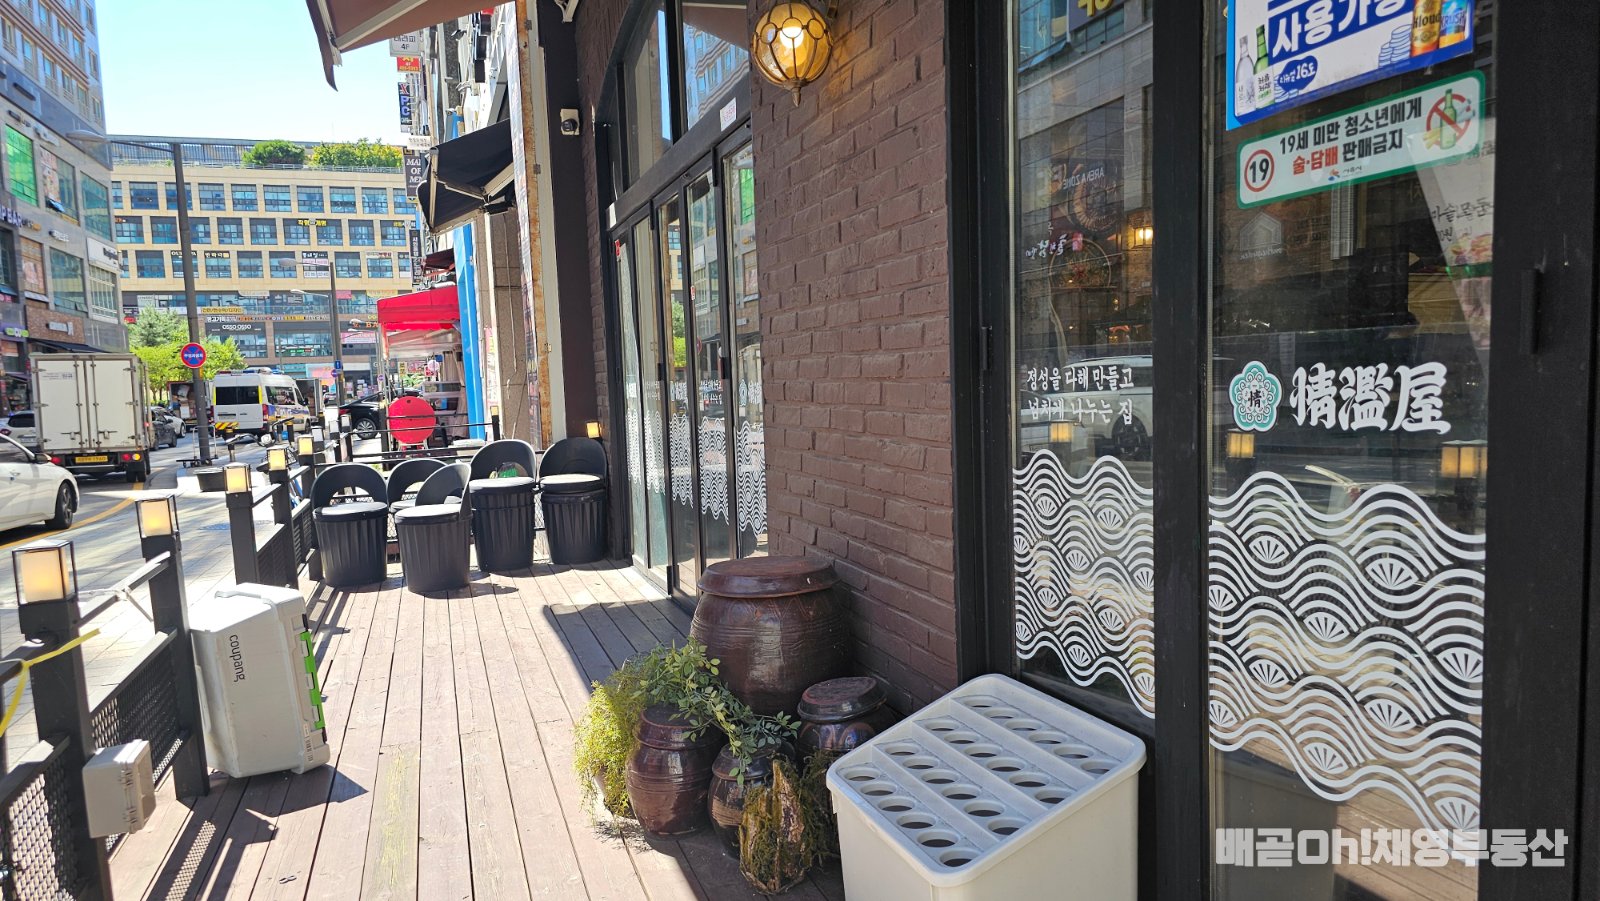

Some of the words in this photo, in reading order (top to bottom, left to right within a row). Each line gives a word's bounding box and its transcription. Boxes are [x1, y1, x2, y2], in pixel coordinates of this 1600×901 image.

[1296, 62, 1316, 80] 16도
[1279, 135, 1309, 155] 19세
[1313, 122, 1341, 145] 미만
[1344, 96, 1422, 138] 청소년에게
[1292, 145, 1338, 176] 술·담배
[1342, 128, 1404, 163] 판매금지
[1249, 157, 1270, 184] 19
[1027, 367, 1062, 391] 정성을
[1065, 365, 1089, 392] 다해
[1092, 365, 1135, 392] 만들고
[1028, 397, 1065, 422] 넘치게
[1071, 397, 1114, 424] 나누는
[1118, 398, 1133, 425] 집
[229, 634, 246, 683] coupang
